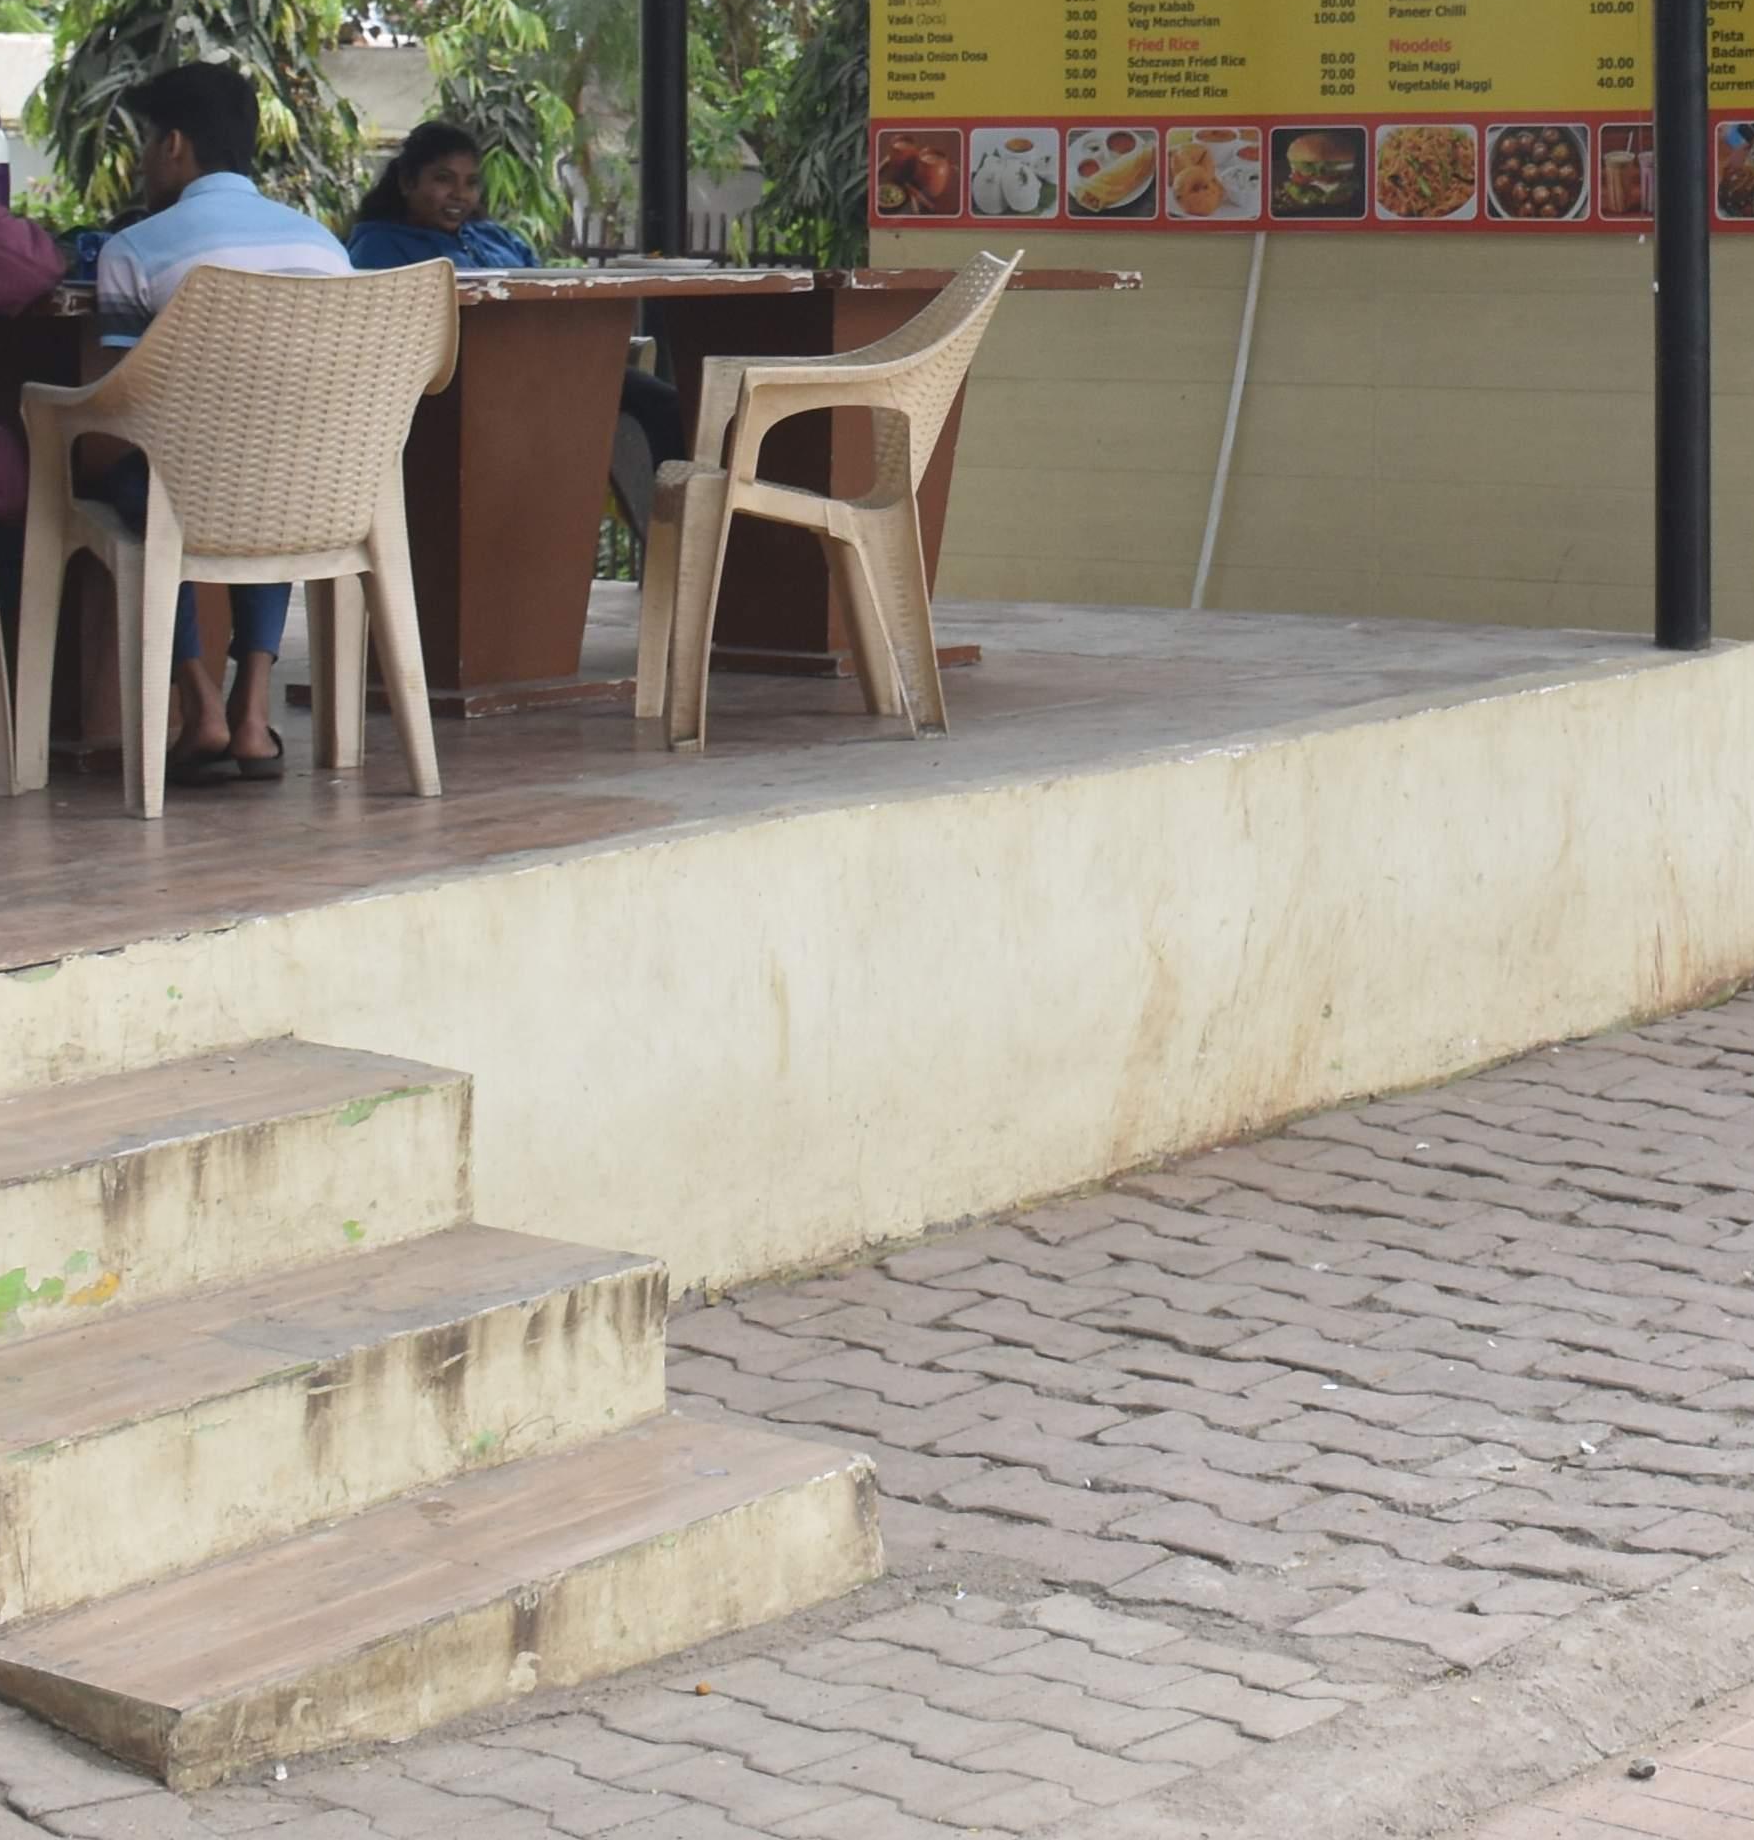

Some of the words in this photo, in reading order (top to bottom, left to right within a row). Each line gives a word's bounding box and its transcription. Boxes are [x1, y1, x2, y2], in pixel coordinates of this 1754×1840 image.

[1128, 2, 1155, 15] Soya
[1159, 1, 1195, 12] Kabab
[1389, 7, 1432, 18] Paneer
[1436, 6, 1466, 17] Chilli
[1591, 2, 1633, 13] 100.00
[888, 15, 913, 25] Vada
[916, 14, 946, 26] (2pcs)
[1066, 10, 1096, 21] 30.00
[1314, 12, 1355, 23] 100.00
[1128, 18, 1149, 30] Veg
[1153, 16, 1220, 28] Manchurian
[888, 34, 924, 43] Masala
[927, 33, 953, 43] Dosa
[1065, 30, 1096, 40] 40.00
[1712, 31, 1744, 42] Pista
[1128, 38, 1164, 52] Fried
[1169, 38, 1199, 50] Rice
[1389, 38, 1452, 53] Noodels
[888, 53, 923, 63] Masala
[927, 52, 958, 61] Onion
[962, 51, 987, 61] Dosa
[1065, 49, 1096, 60] 50.00
[1321, 53, 1355, 64] 80.00
[1128, 57, 1184, 68] Schezwan
[1188, 56, 1217, 66] Fried
[1221, 56, 1246, 66] Rice
[1389, 61, 1419, 72] Plain
[1423, 61, 1460, 74] Maggi
[1597, 58, 1633, 69] 30.00
[888, 72, 916, 82] Rawa
[920, 71, 945, 80] Dosa
[1065, 69, 1096, 79] 50.00
[1128, 73, 1149, 84] Veg
[1153, 72, 1181, 82] Fried
[1185, 71, 1209, 82] Rice
[1321, 69, 1355, 79] 70.00
[1389, 80, 1450, 93] Vegetable
[1454, 79, 1492, 92] Maggi
[1597, 77, 1633, 88] 40.00
[1065, 88, 1096, 98] 50.00
[1128, 88, 1167, 98] Paneer
[1171, 87, 1199, 97] Fried
[1203, 87, 1227, 97] Rice
[1321, 84, 1355, 96] 80.00
[888, 90, 934, 102] Uthapam
